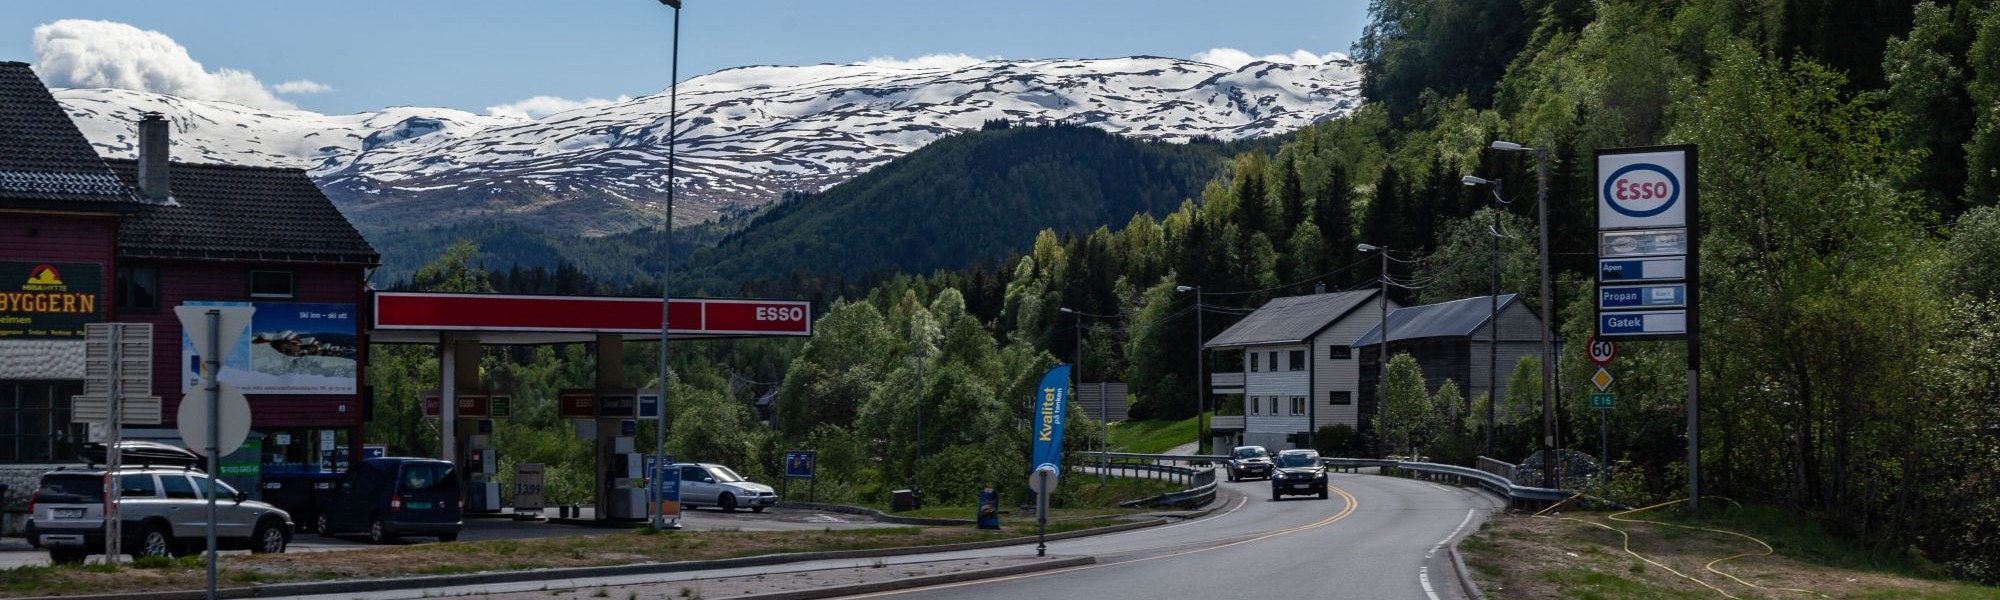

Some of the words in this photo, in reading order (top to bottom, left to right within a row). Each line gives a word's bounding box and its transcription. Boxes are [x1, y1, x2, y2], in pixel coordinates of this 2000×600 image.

[1604, 292, 1637, 302] Propan
[756, 307, 803, 321] ESSO
[1608, 317, 1641, 327] Gatek
[1593, 341, 1611, 357] 60
[1594, 396, 1611, 405] E16
[1040, 387, 1055, 441] Kvalitet
